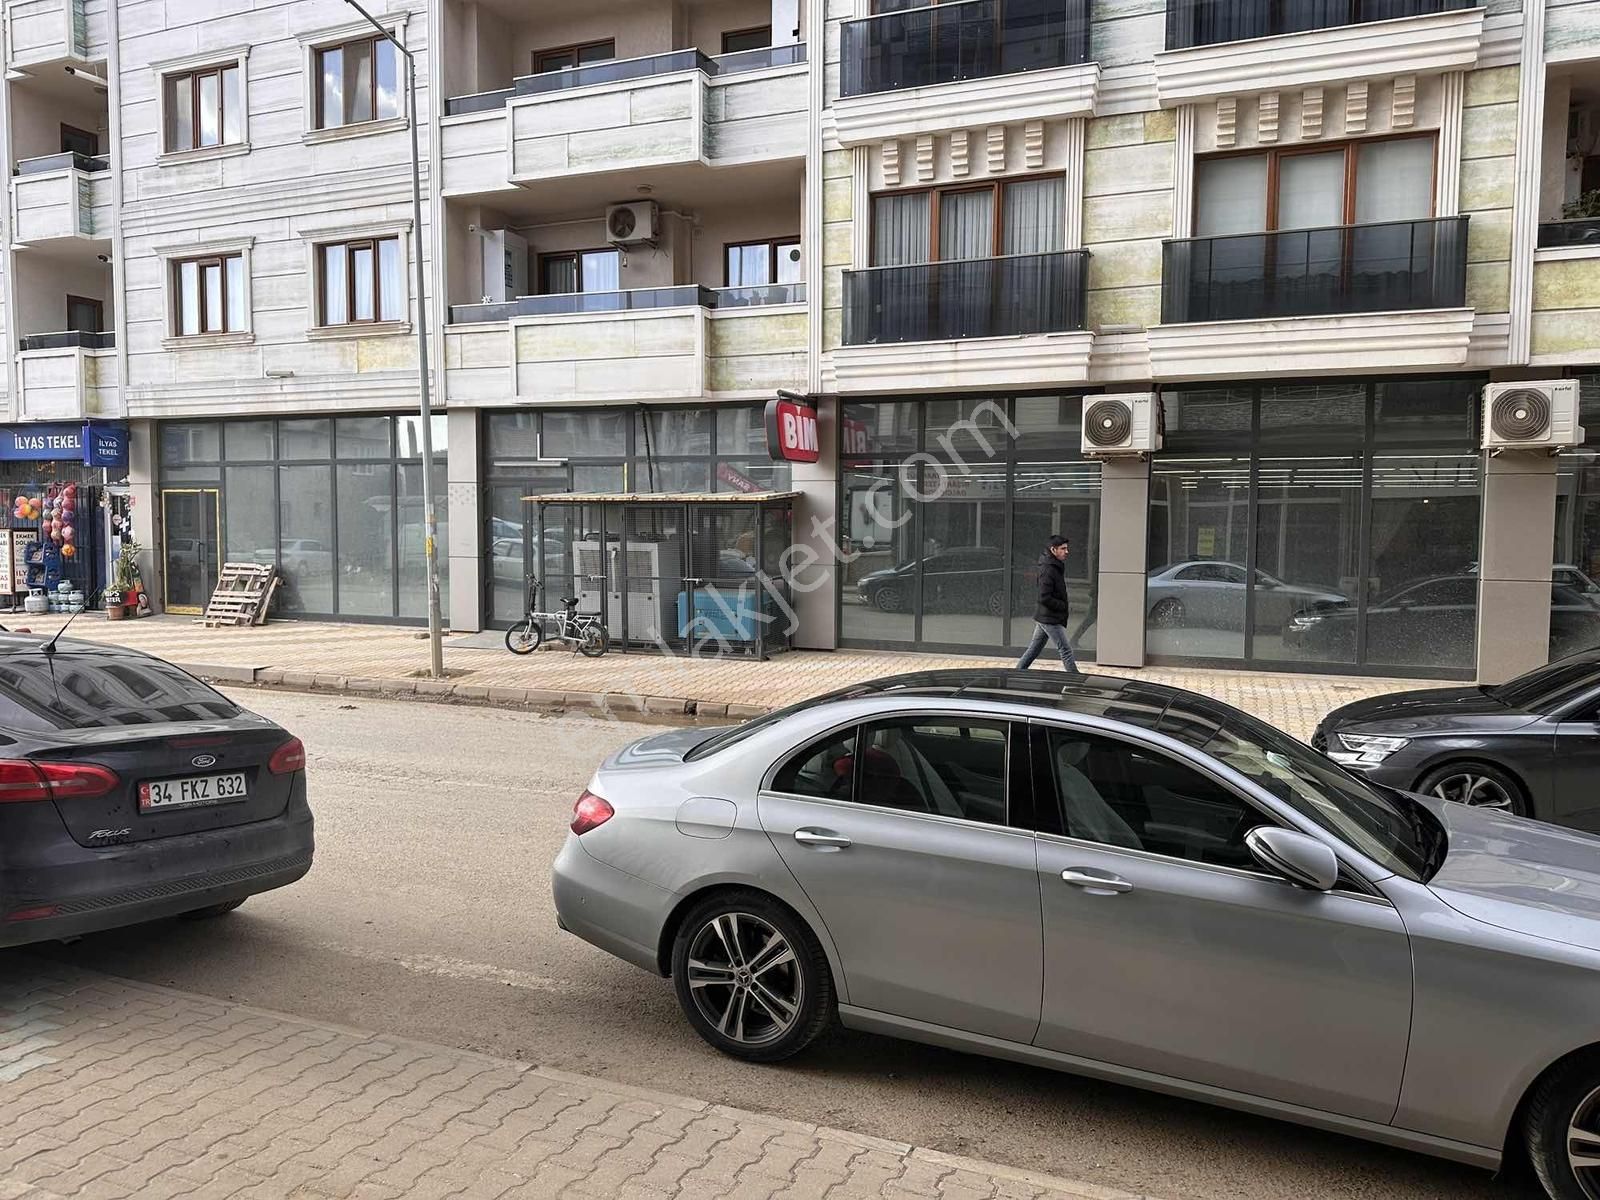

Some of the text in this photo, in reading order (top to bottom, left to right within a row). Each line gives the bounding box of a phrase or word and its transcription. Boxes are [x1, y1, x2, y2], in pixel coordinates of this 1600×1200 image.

[14, 433, 81, 450] İLYAS TEKEL
[98, 448, 118, 456] TEKEL
[151, 783, 172, 804] 34
[180, 779, 210, 801] FKZ
[216, 776, 244, 796] 632
